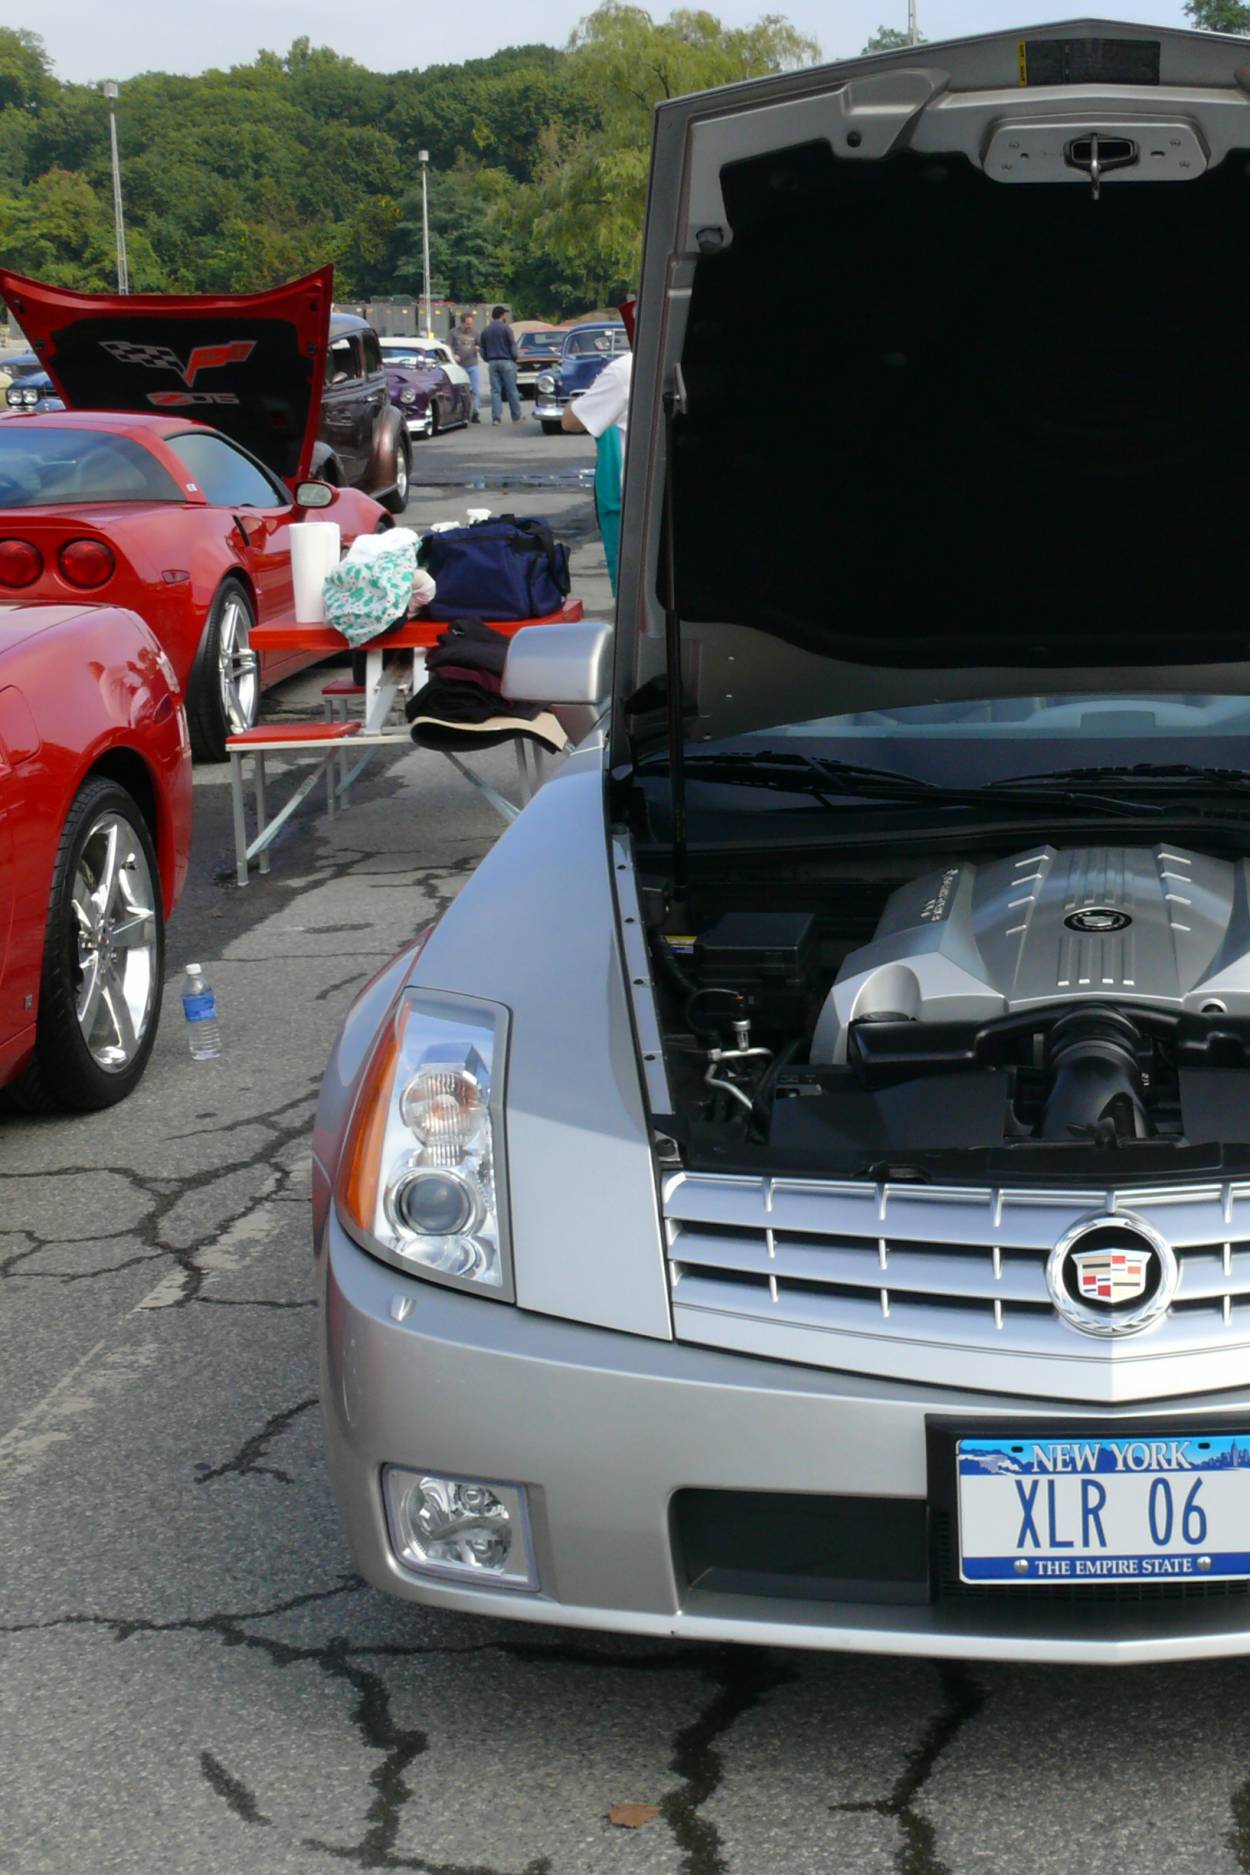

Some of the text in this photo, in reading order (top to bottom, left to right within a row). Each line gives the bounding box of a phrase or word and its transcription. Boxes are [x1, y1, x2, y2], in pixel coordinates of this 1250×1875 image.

[1031, 1441, 1192, 1472] NEW YORK
[1015, 1477, 1208, 1549] XLR 06
[1035, 1558, 1193, 1575] THE EMPIRE STATE
